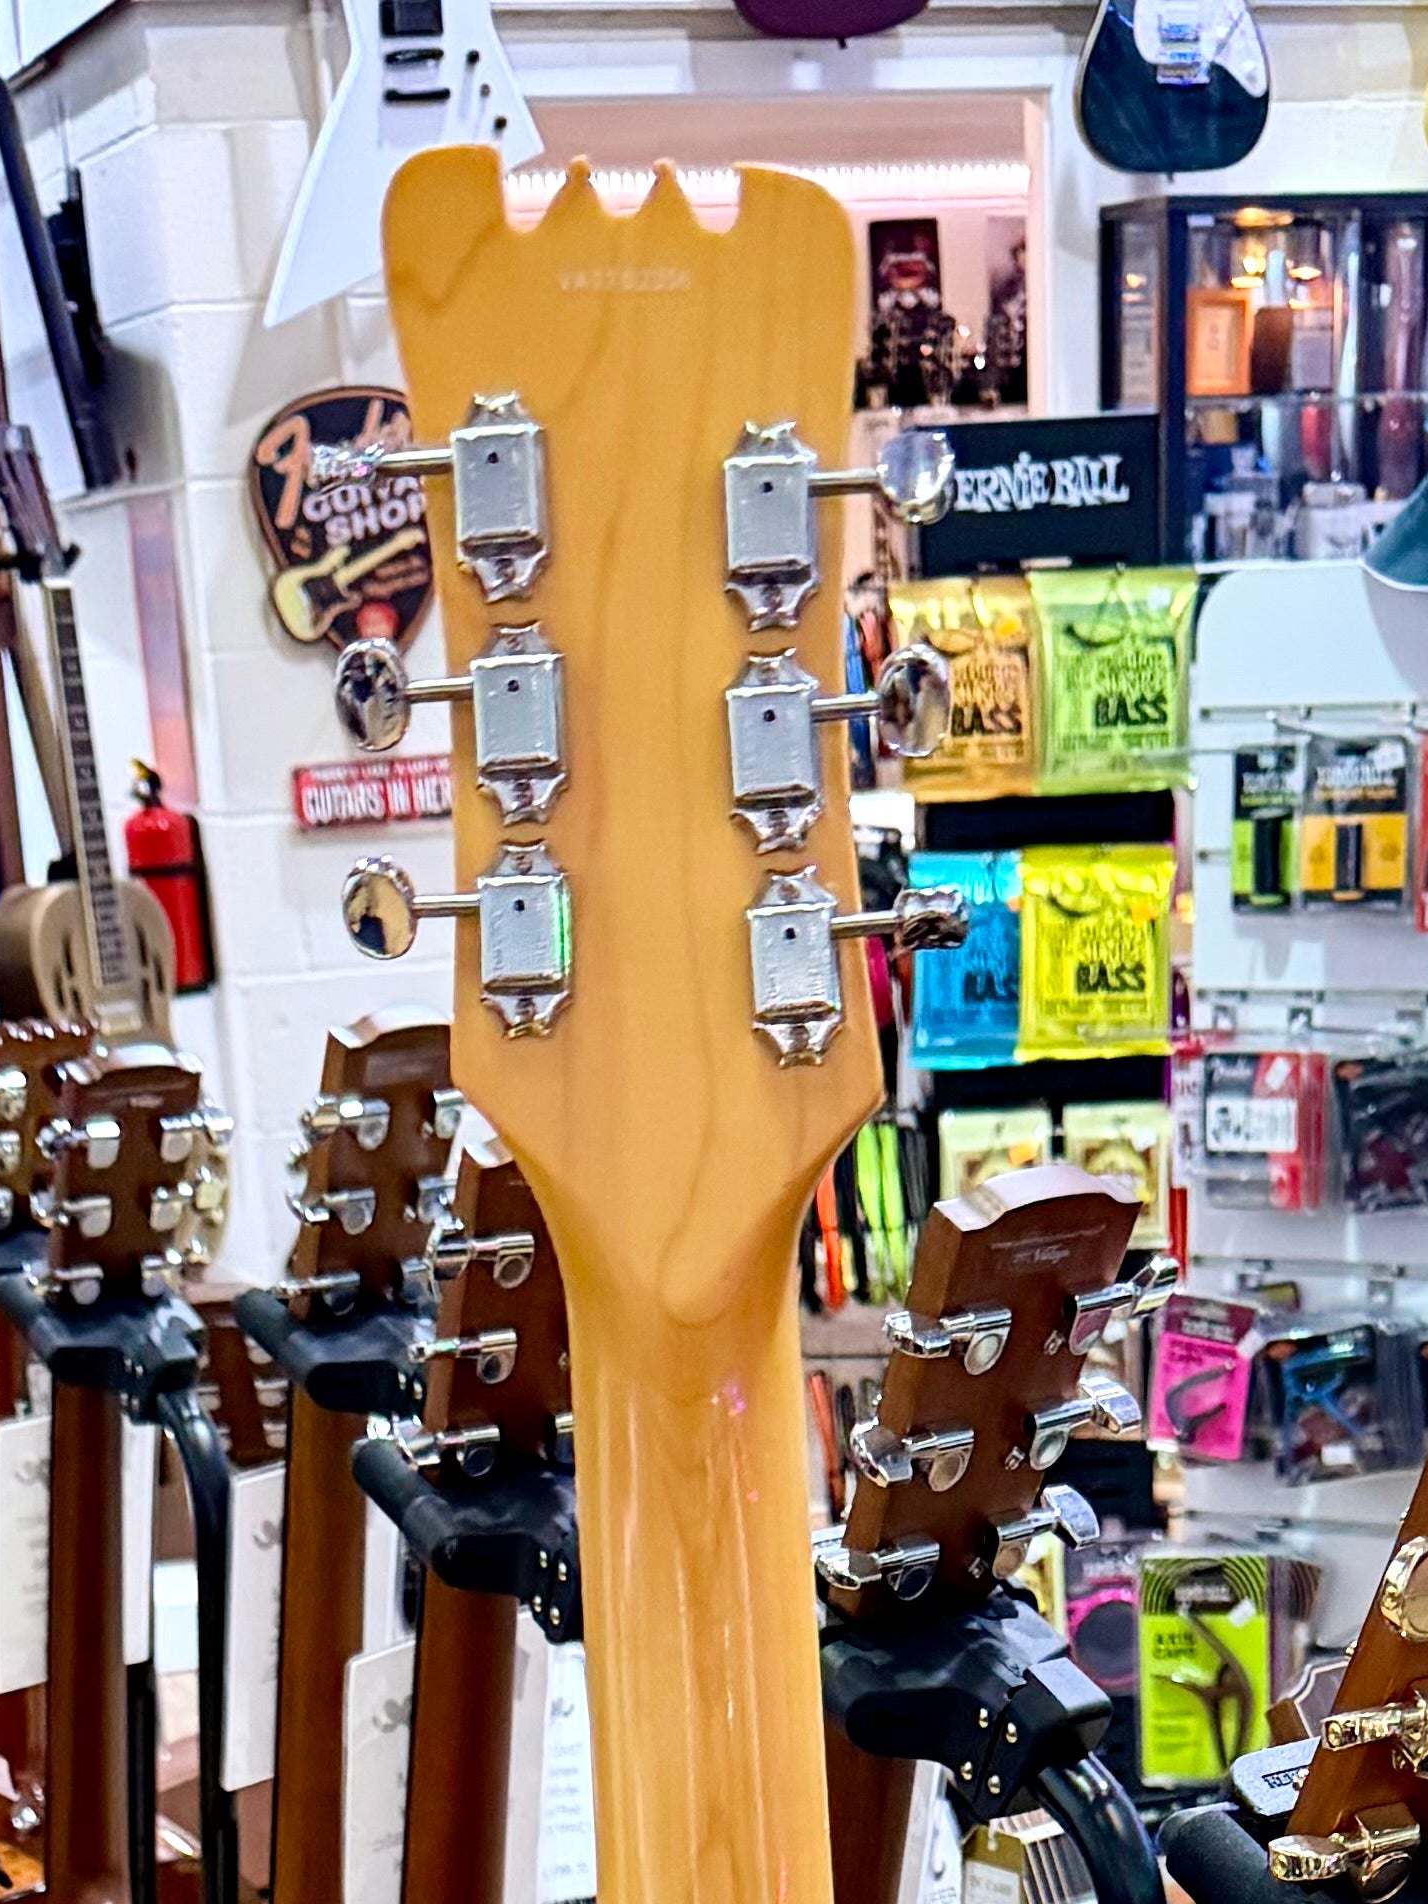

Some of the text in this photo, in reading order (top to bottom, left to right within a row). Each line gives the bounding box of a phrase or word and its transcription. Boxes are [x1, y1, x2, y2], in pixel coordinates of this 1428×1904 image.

[1050, 454, 1130, 508] BALL
[1095, 694, 1168, 728] BASS
[1077, 961, 1147, 993] BASS
